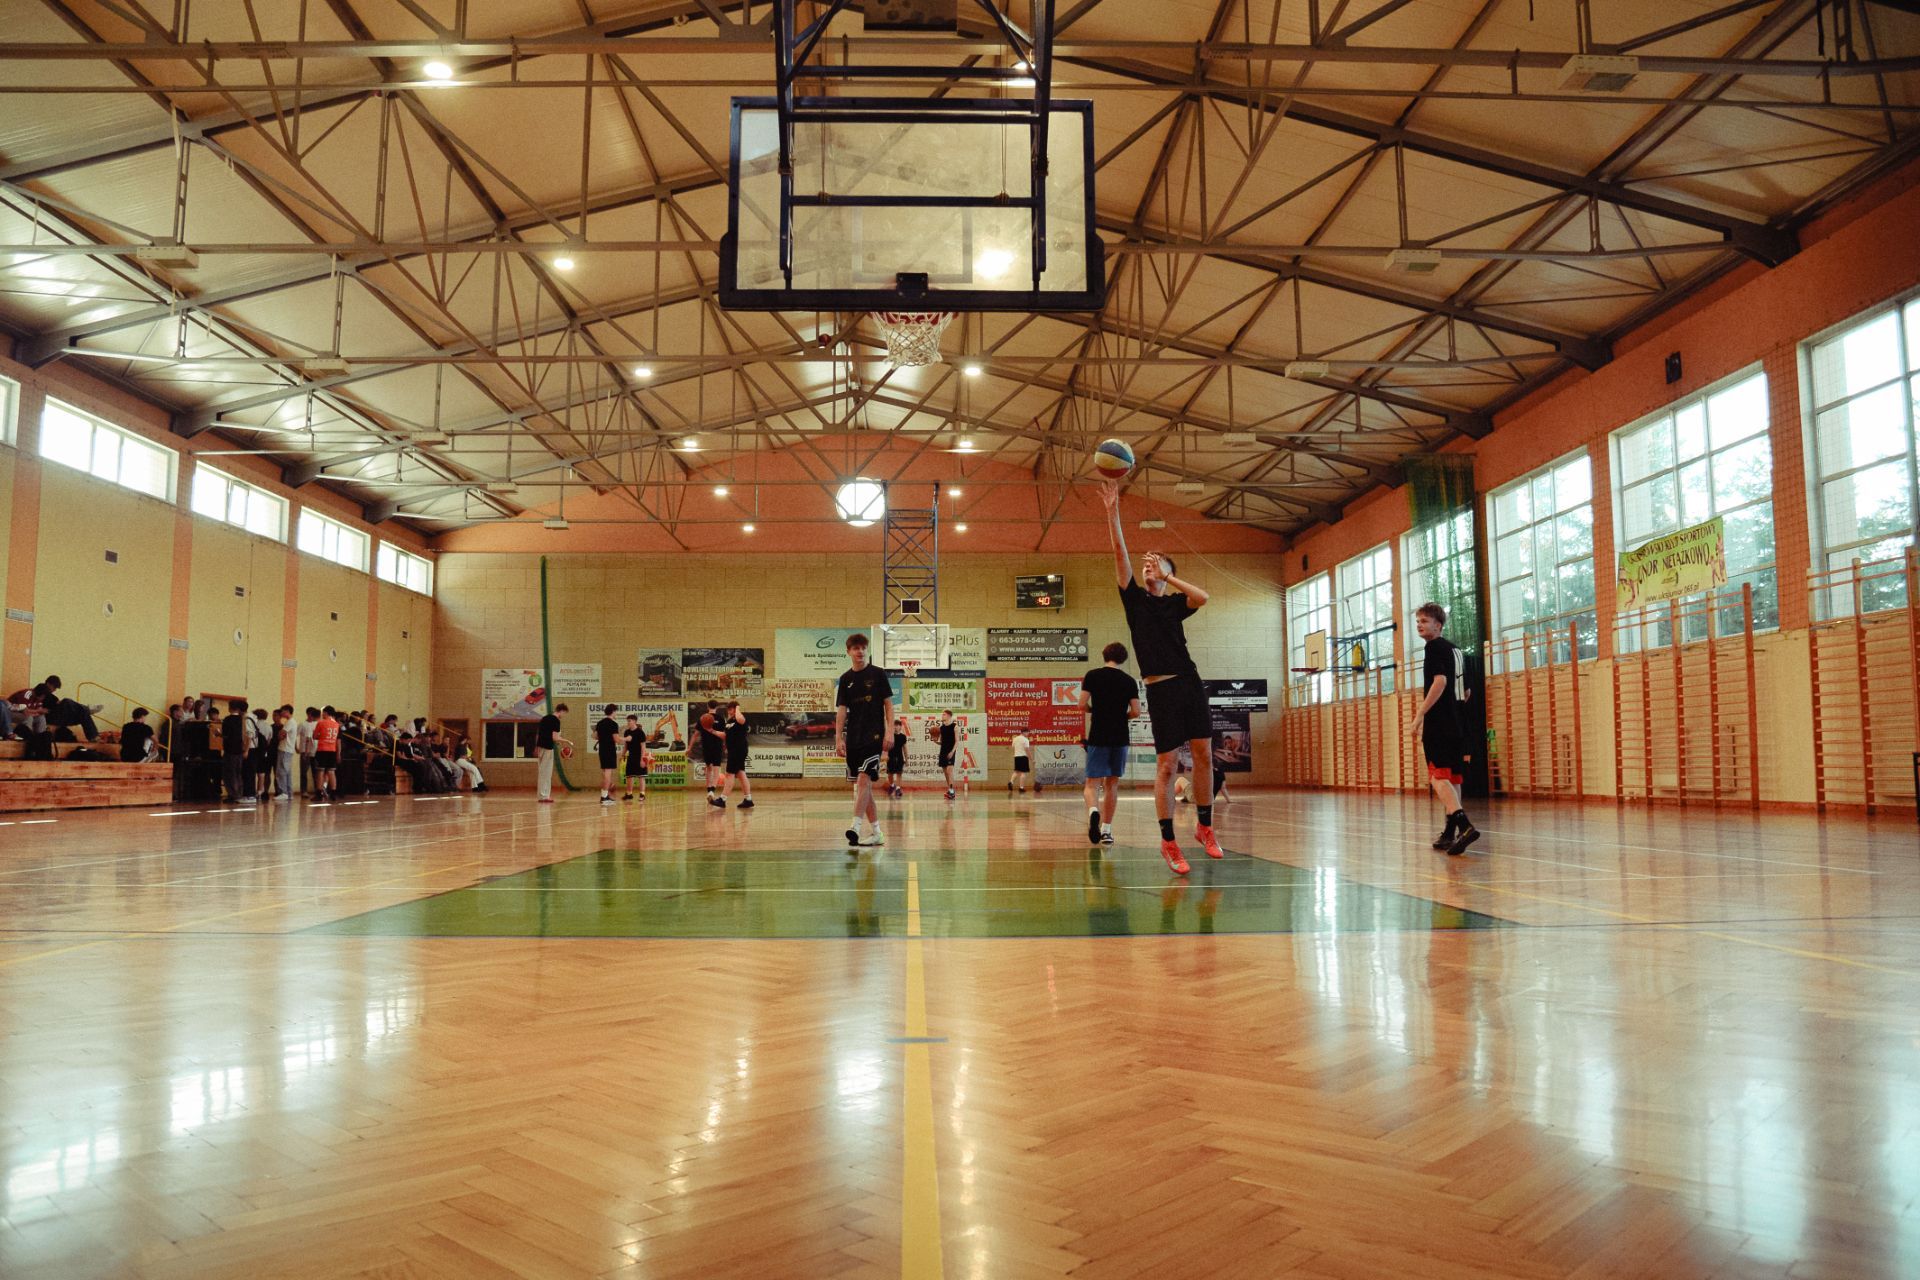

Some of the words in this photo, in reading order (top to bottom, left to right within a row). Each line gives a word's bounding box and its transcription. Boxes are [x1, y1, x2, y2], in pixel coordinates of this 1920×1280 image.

[1679, 524, 1715, 543] SPORTOWY
[914, 681, 939, 690] POMPY
[940, 681, 966, 690] CIEPŁA
[987, 681, 1009, 690] Skup
[1009, 681, 1035, 690] złomu
[987, 689, 1024, 699] Sprzedaż
[1024, 690, 1049, 700] węgla
[625, 704, 684, 712] BRUKARSKIE
[988, 708, 1031, 718] Nietążkowo
[1042, 761, 1078, 769] undersun
